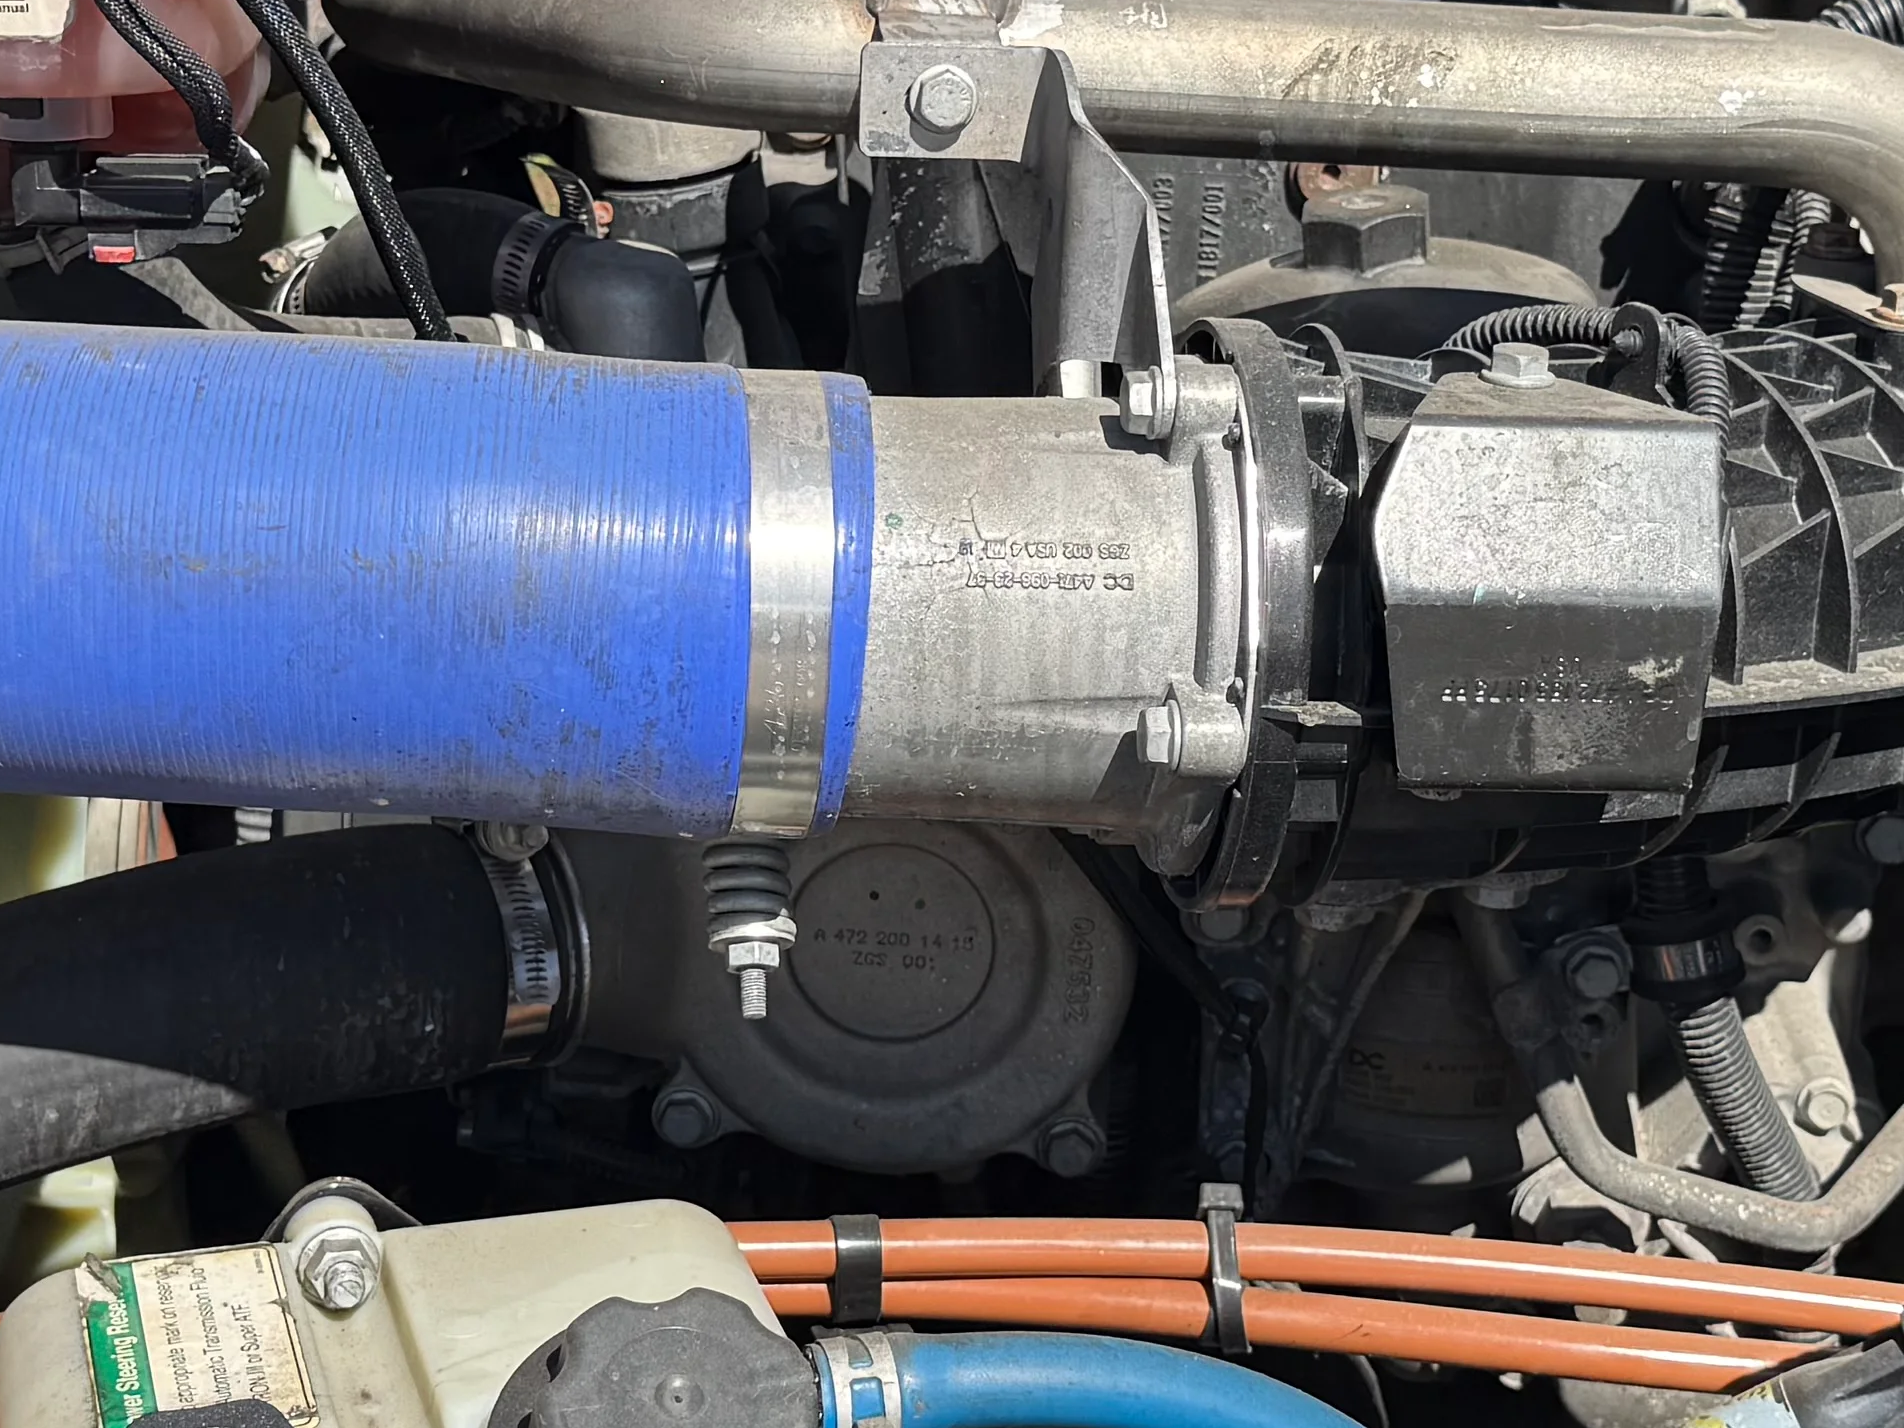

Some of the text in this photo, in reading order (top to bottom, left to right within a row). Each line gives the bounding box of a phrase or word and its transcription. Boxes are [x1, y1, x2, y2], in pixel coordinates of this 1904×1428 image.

[1027, 542, 1059, 558] USA
[1099, 542, 1130, 559] ZGS
[834, 929, 868, 946] 472
[875, 932, 911, 948] 200
[853, 951, 890, 968] ZGS
[162, 1306, 178, 1320] on
[160, 1320, 182, 1346] mark
[195, 1298, 223, 1356] Transmission
[240, 1325, 262, 1353] Super
[116, 1336, 141, 1392] Steering
